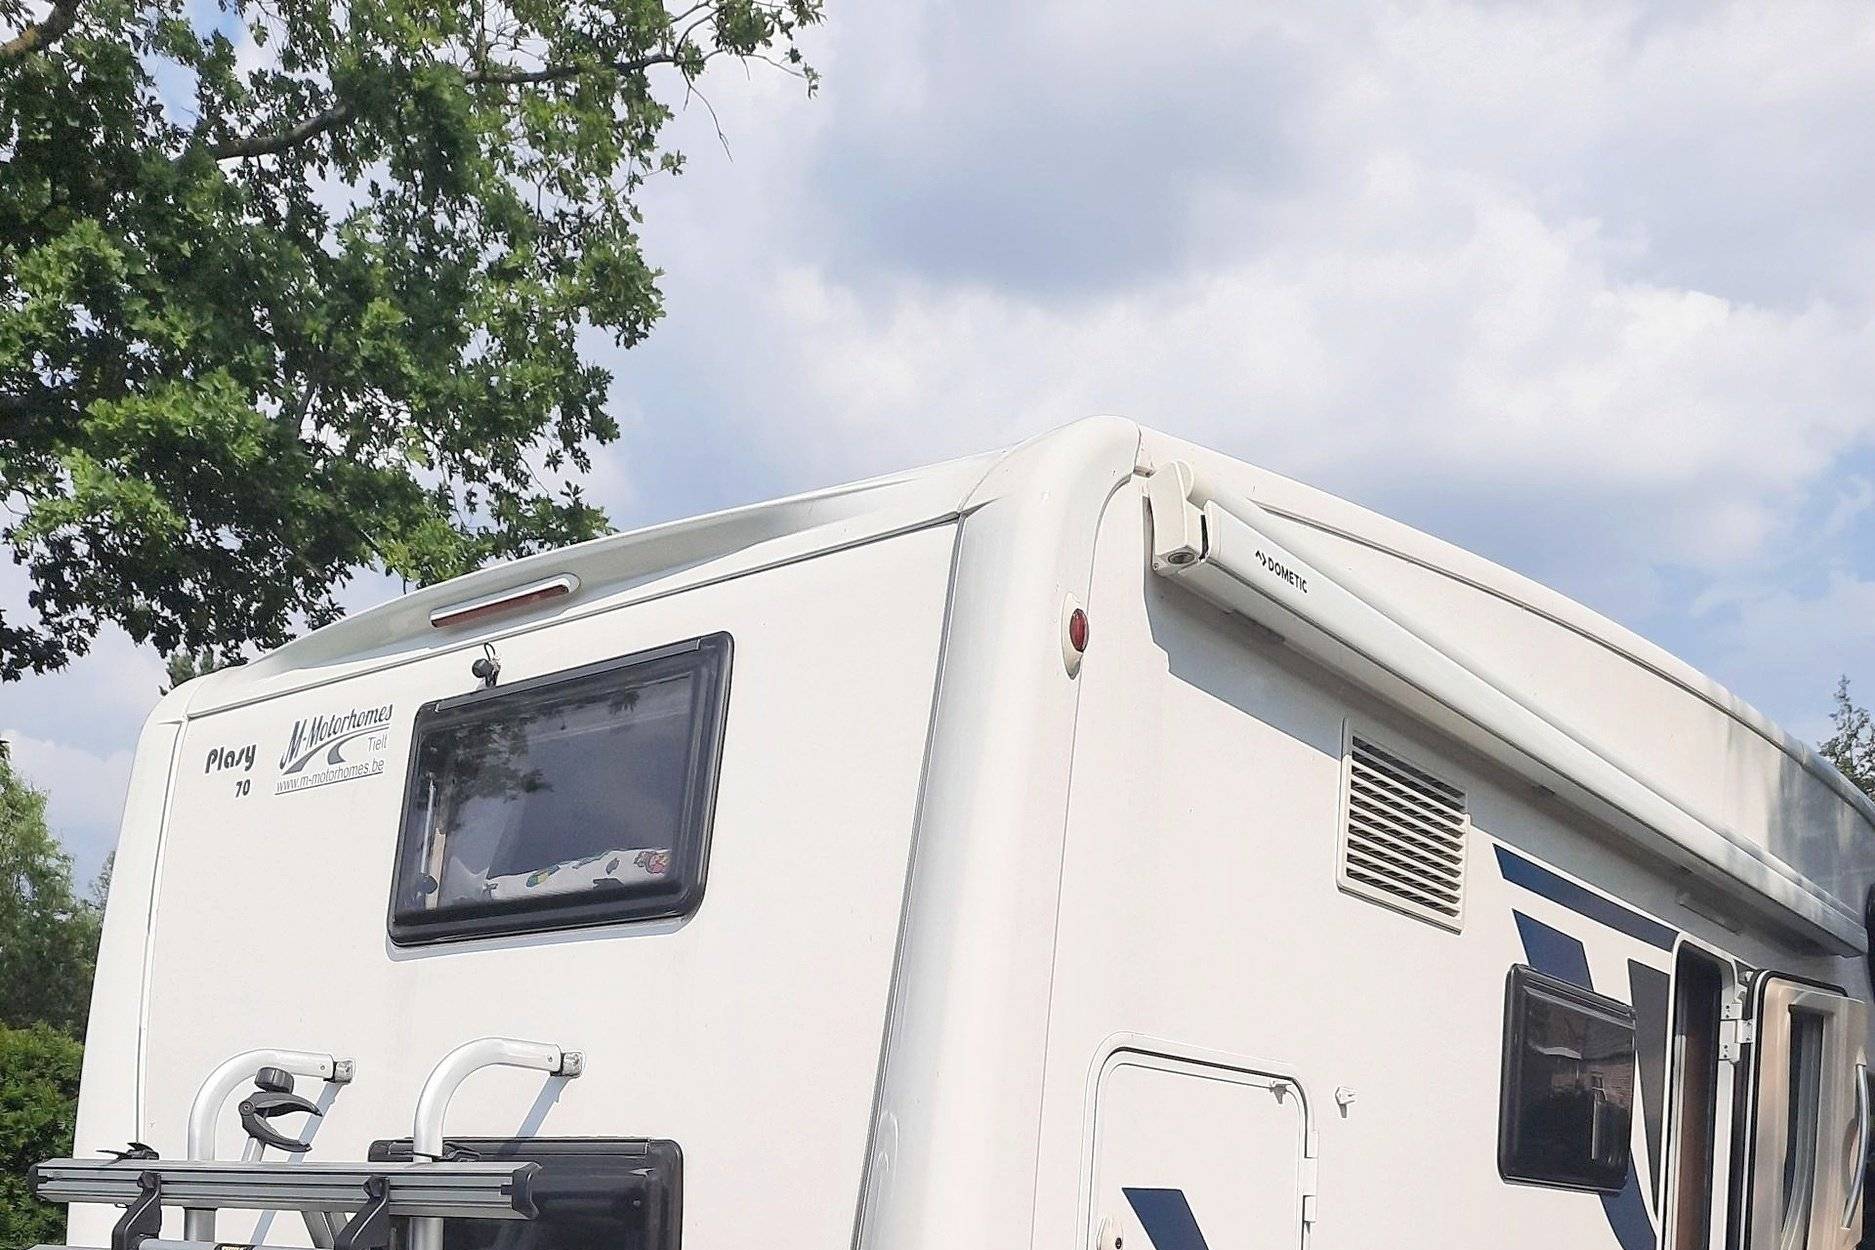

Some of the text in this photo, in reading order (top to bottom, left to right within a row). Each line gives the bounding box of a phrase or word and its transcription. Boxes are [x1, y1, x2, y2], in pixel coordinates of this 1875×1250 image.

[1268, 556, 1308, 594] DOMETIC
[279, 704, 393, 770] M-Motorhomes
[205, 744, 257, 774] Plasy
[276, 758, 385, 793] www.m-motorhomes.be
[235, 779, 251, 798] 70
